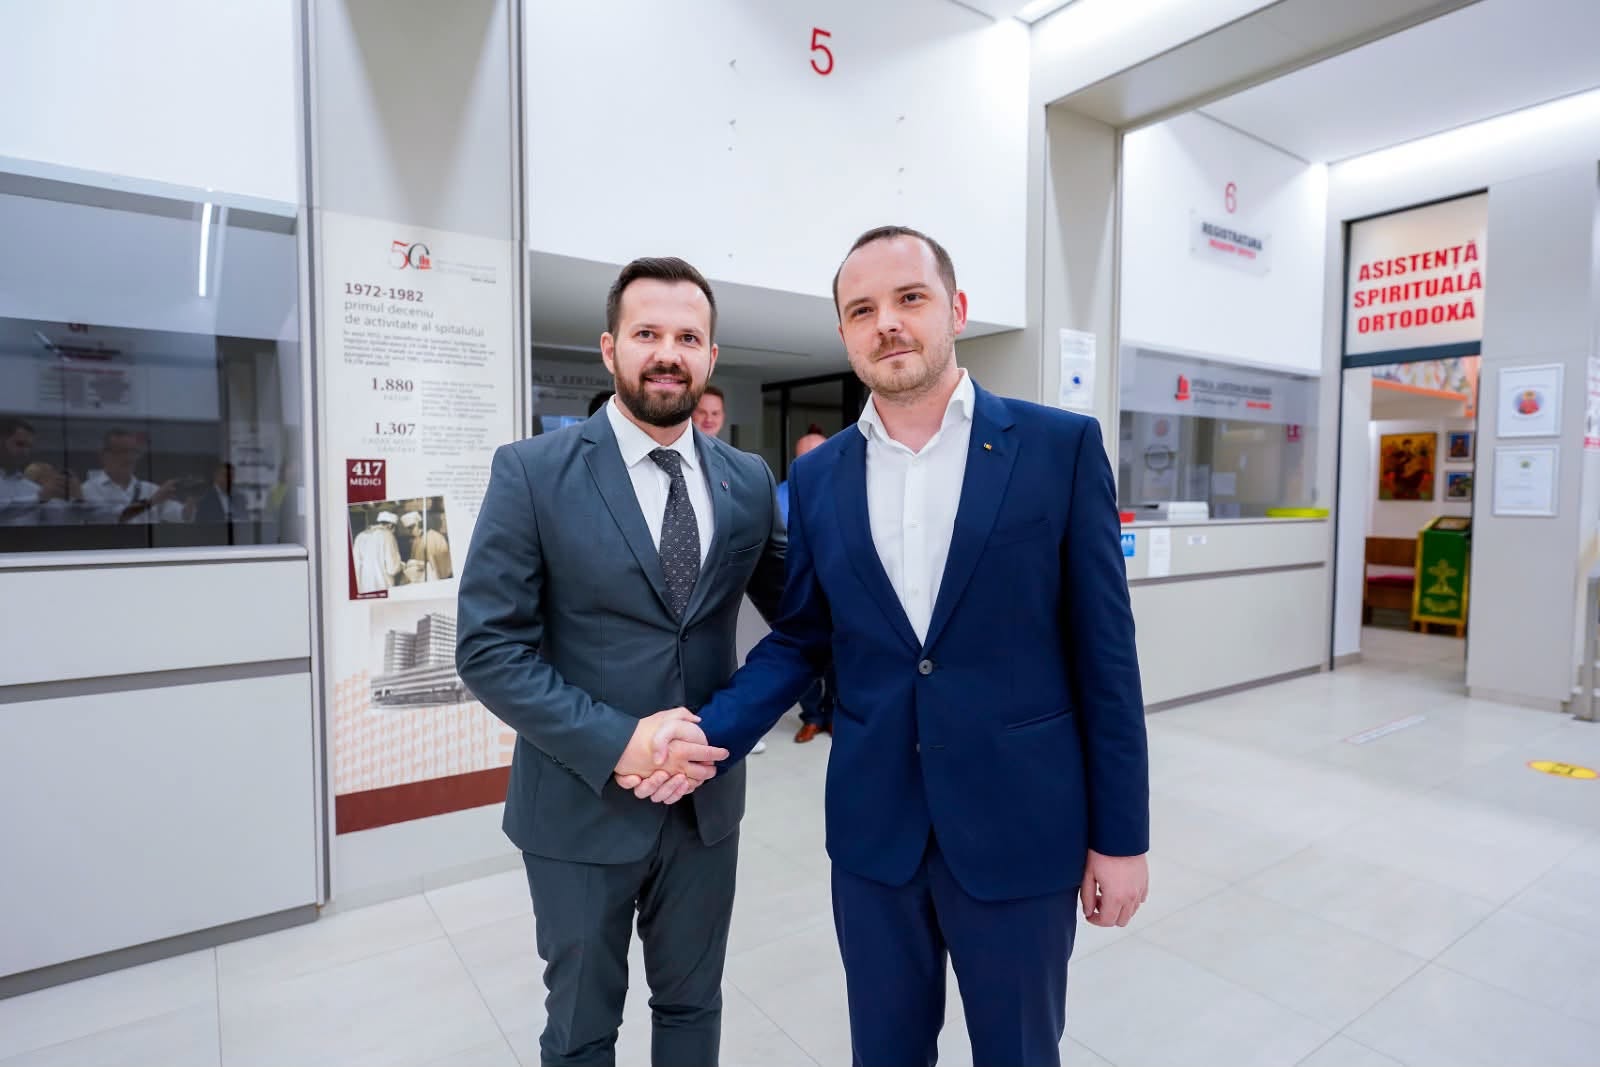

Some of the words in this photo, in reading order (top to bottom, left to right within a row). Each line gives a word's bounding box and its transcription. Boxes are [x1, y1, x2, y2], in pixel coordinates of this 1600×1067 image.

[810, 27, 834, 76] 5
[1225, 181, 1237, 214] 6
[1201, 221, 1263, 251] REGISTRATURA
[344, 282, 424, 303] 1972-1982
[1354, 270, 1482, 308] SPIRITUALĂ
[344, 300, 384, 315] primul
[387, 303, 434, 319] deceniu
[1357, 298, 1476, 334] ORTODOXĂ
[345, 314, 361, 325] de
[364, 316, 418, 331] activitate
[421, 322, 431, 332] al
[435, 323, 484, 338] spitalului
[371, 377, 414, 393] 1.880
[375, 422, 416, 437] 1.307
[351, 461, 383, 476] 417
[349, 477, 382, 486] MEDICI
